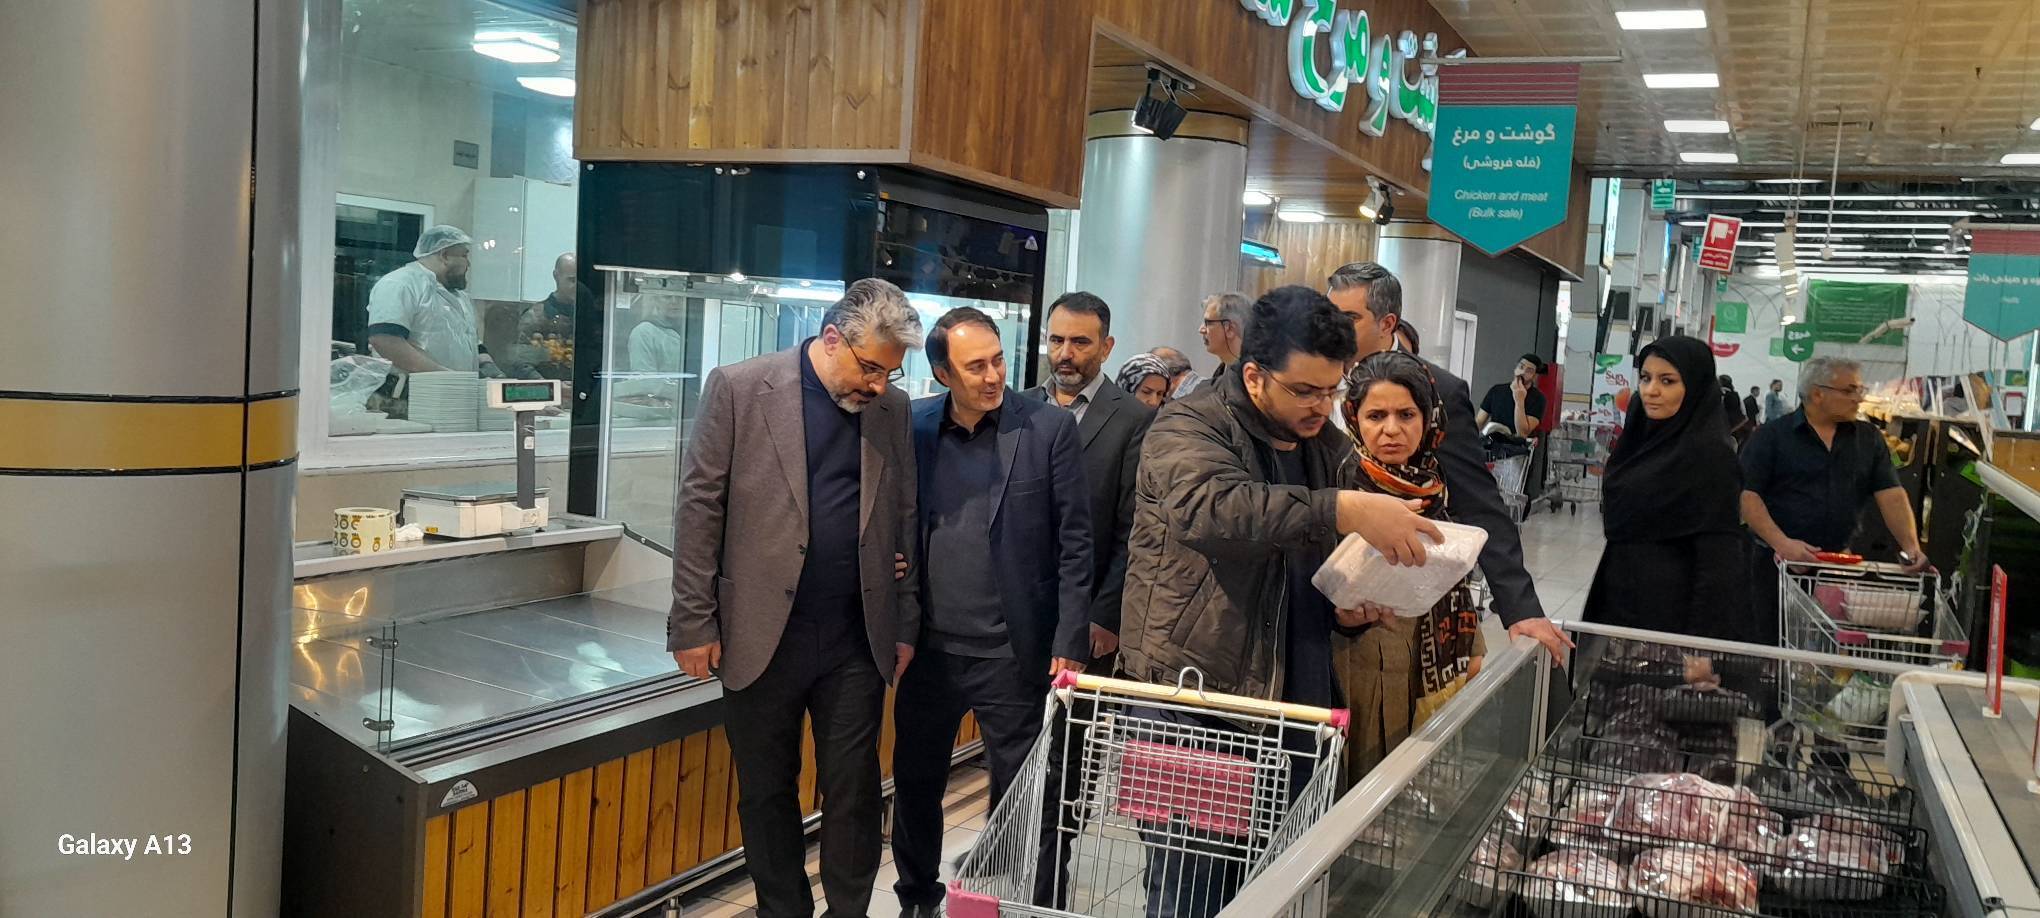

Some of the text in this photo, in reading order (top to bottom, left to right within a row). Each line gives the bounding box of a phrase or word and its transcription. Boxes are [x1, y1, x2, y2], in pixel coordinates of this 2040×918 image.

[1359, 34, 1391, 137] و
[1452, 123, 1556, 147] گوشت و مرغ
[1463, 155, 1541, 170] (فله فروشی)
[1454, 189, 1548, 202] Chicken and meat
[1468, 206, 1523, 220] (Bulk sale)
